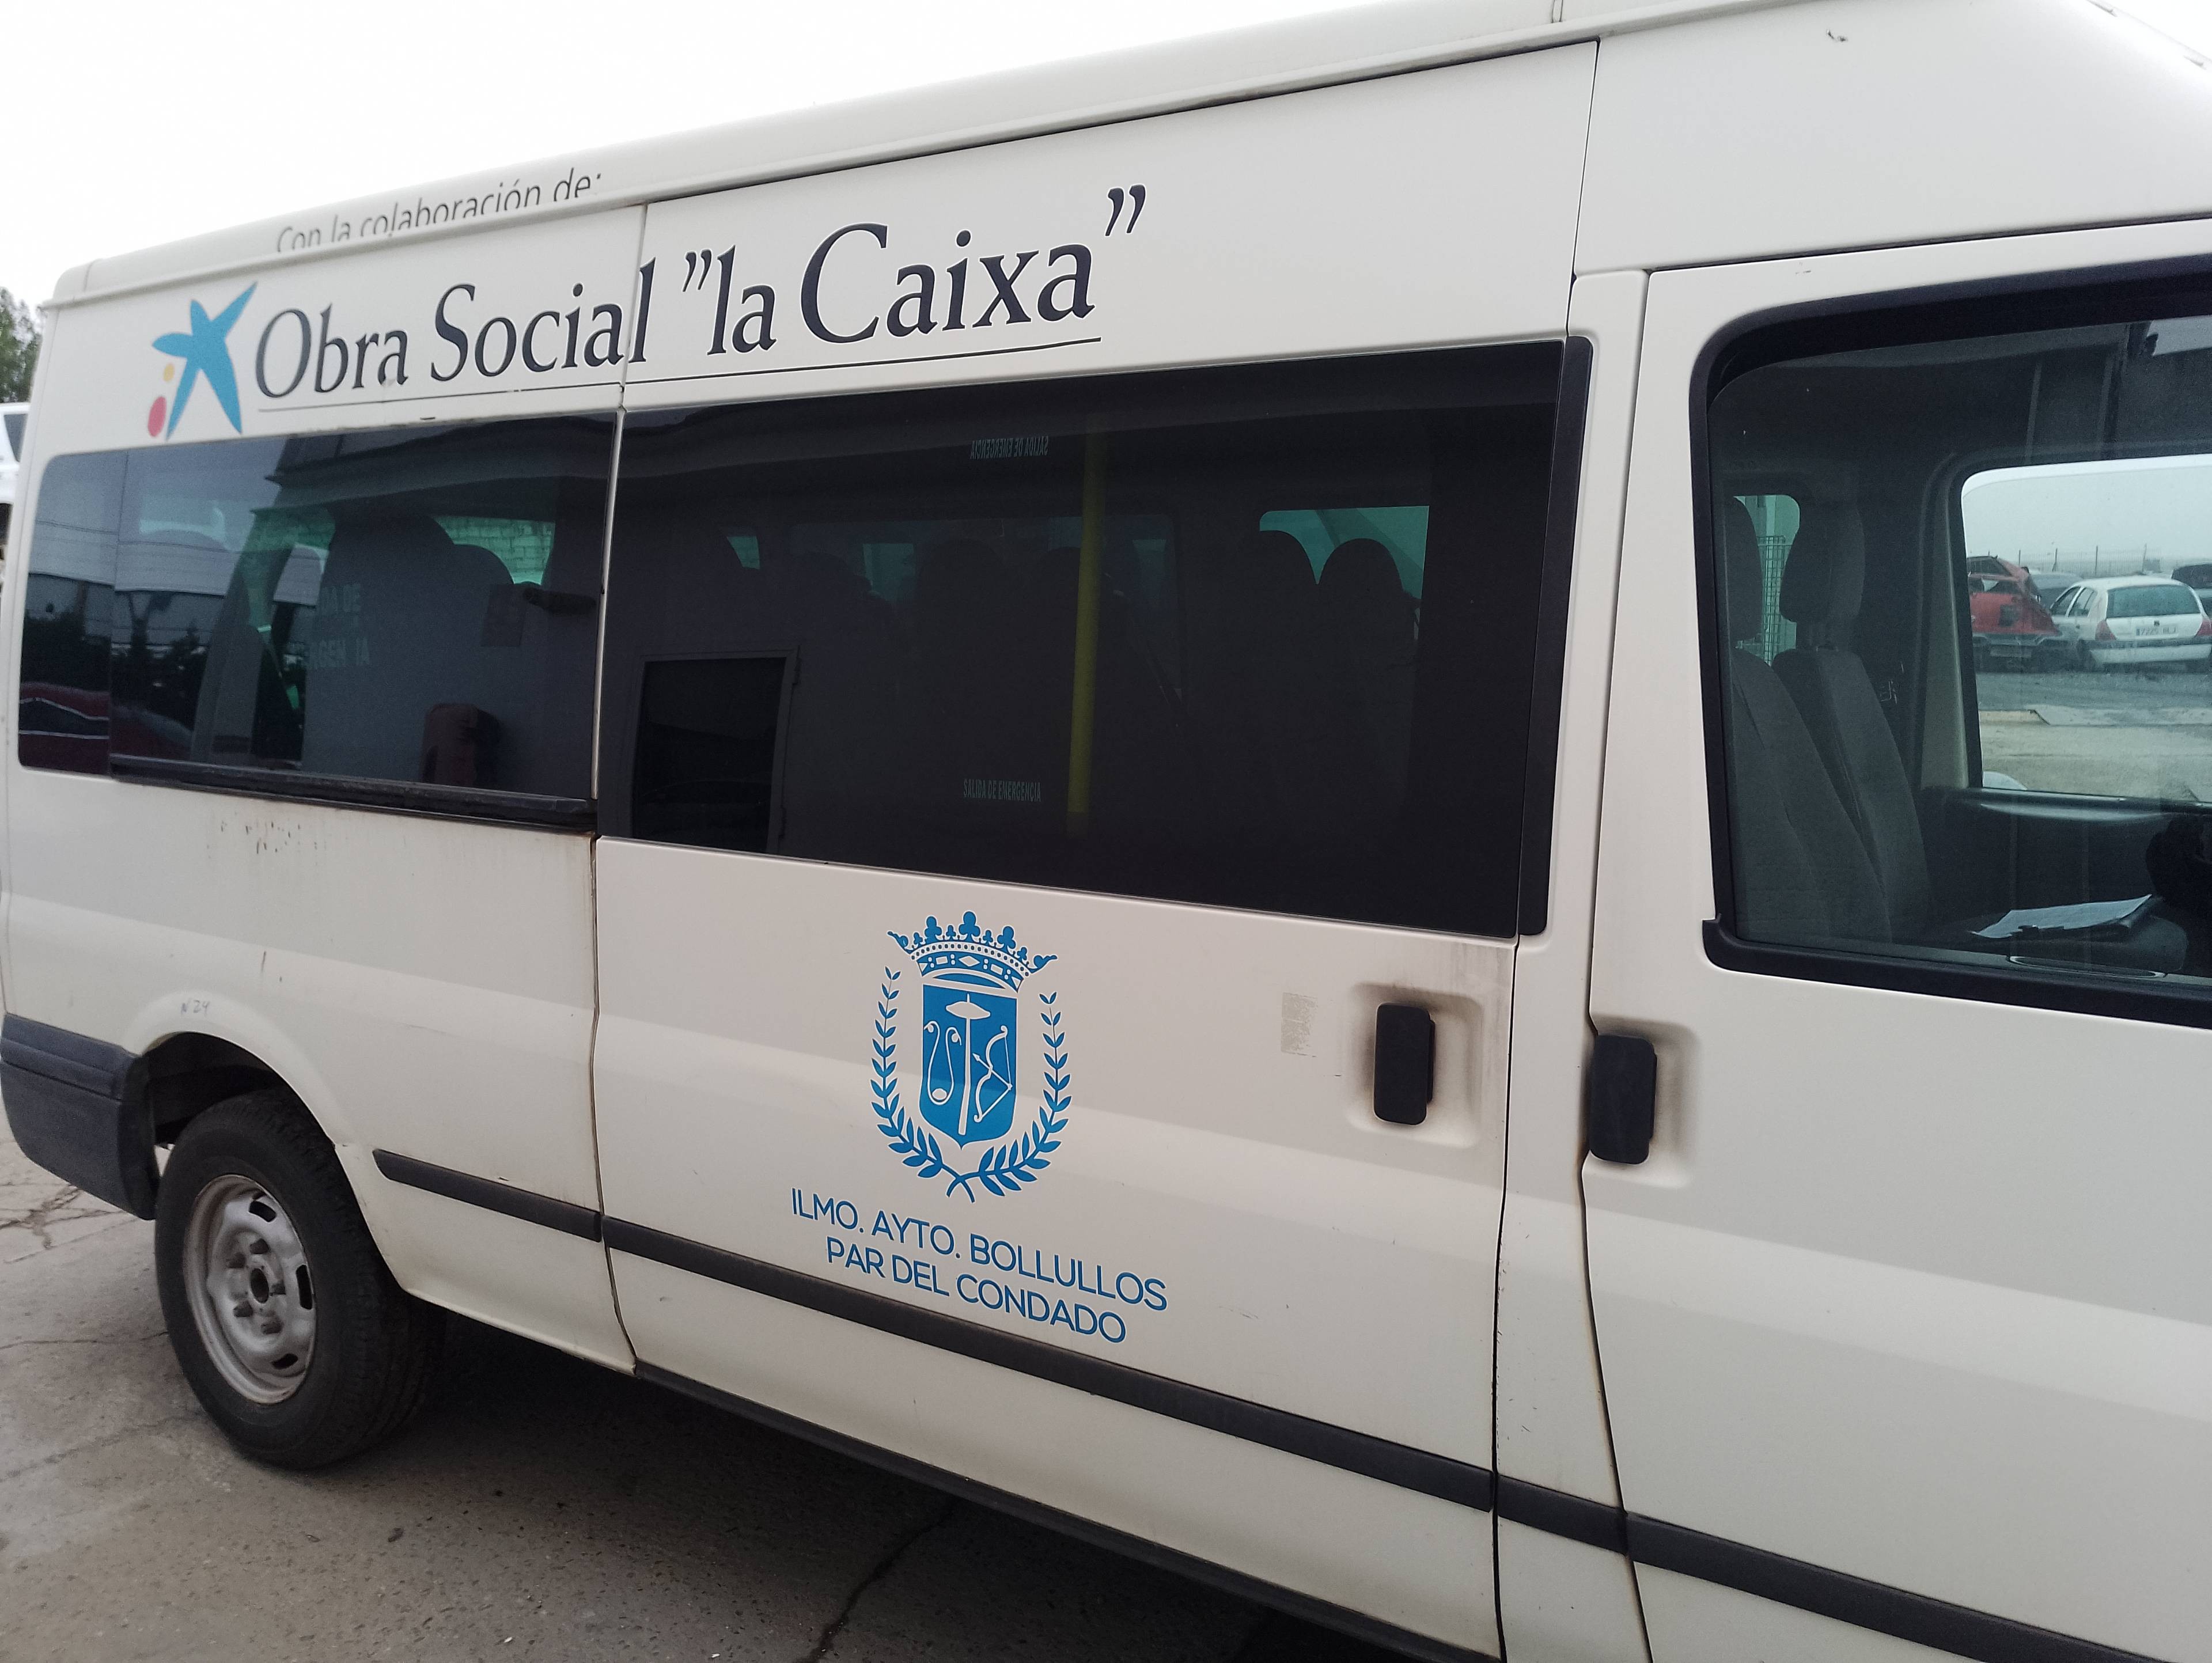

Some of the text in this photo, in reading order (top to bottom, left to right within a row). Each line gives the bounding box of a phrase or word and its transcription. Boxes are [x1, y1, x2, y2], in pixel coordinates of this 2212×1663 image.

[276, 225, 321, 252] Con
[331, 214, 351, 243] la
[360, 178, 541, 237] colaboración
[255, 303, 409, 399] Obra
[430, 257, 656, 382] Social
[964, 779, 1041, 801] SALIDA DE EMERGENCIA
[791, 1188, 1168, 1311] ILMO. AYTO. BOLLULLOS
[826, 1236, 1127, 1343] PAR DEL CONDADO
